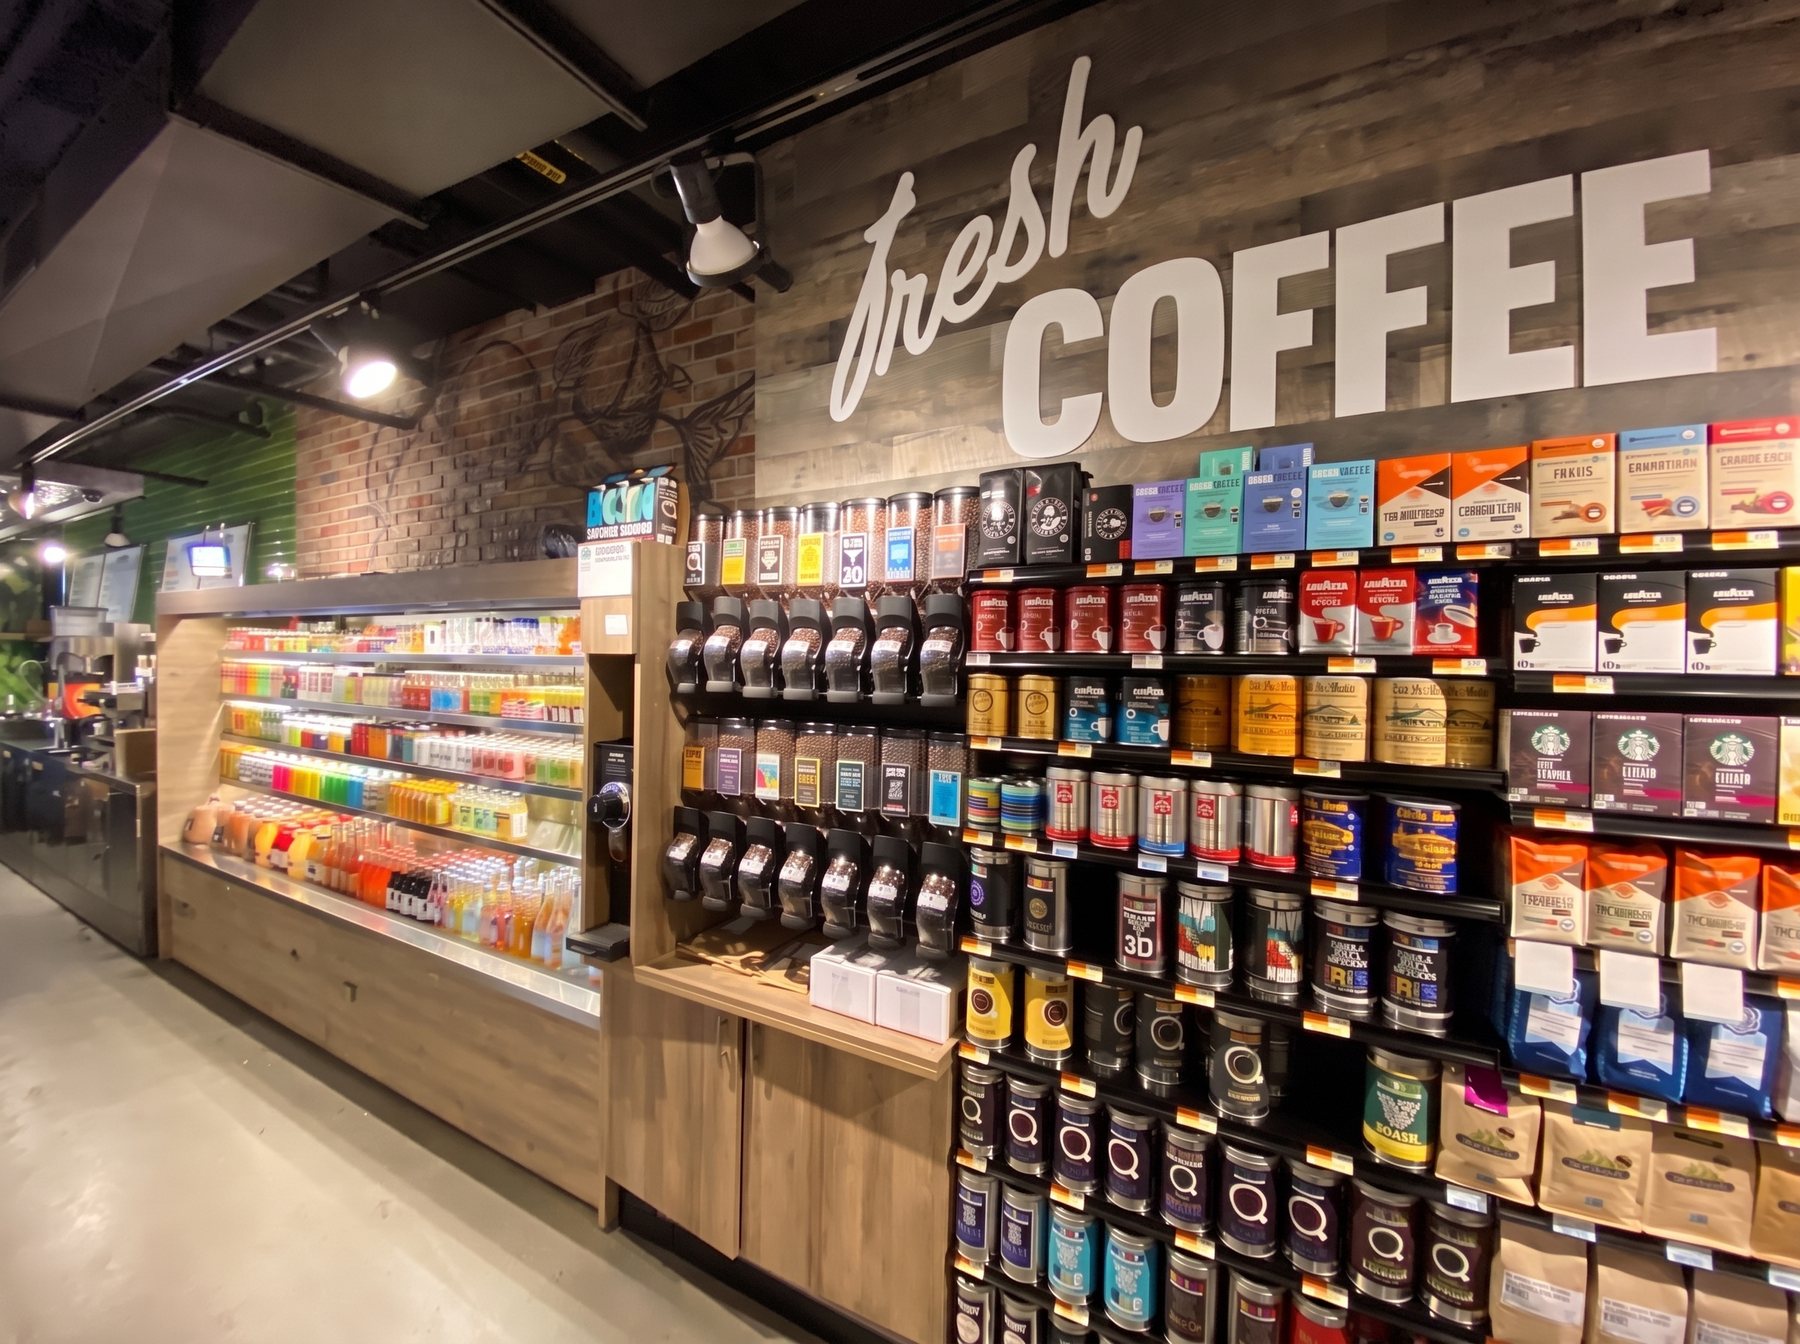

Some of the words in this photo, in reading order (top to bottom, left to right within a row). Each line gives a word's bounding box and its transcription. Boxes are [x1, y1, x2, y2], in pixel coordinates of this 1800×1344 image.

[829, 56, 1143, 422] fresh
[1002, 149, 1718, 458] COFFEE
[1124, 934, 1153, 958] 3D
